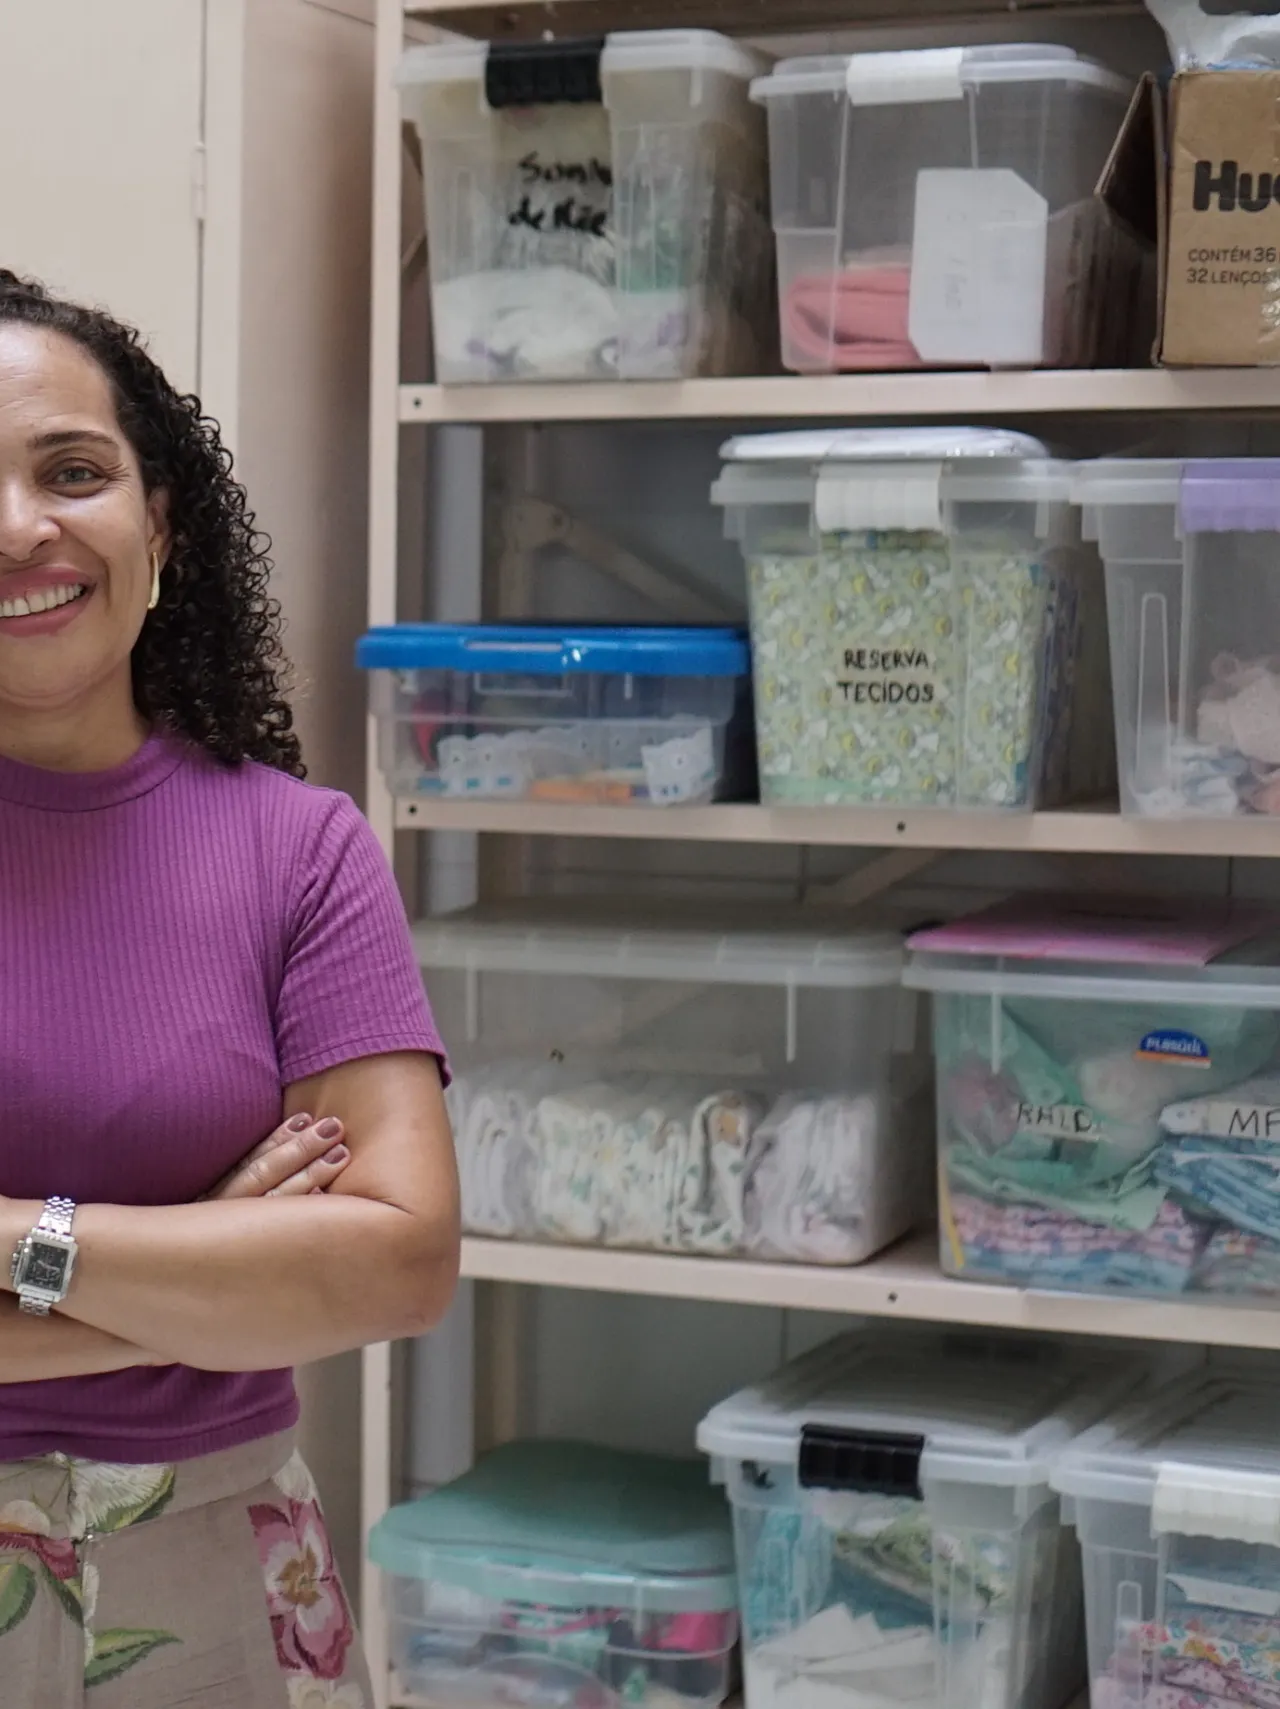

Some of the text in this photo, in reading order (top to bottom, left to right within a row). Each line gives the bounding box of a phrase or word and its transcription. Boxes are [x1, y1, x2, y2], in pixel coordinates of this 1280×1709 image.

[1188, 245, 1277, 263] CONTÉM 36
[1186, 267, 1208, 284] 32
[844, 648, 929, 671] RESERVA
